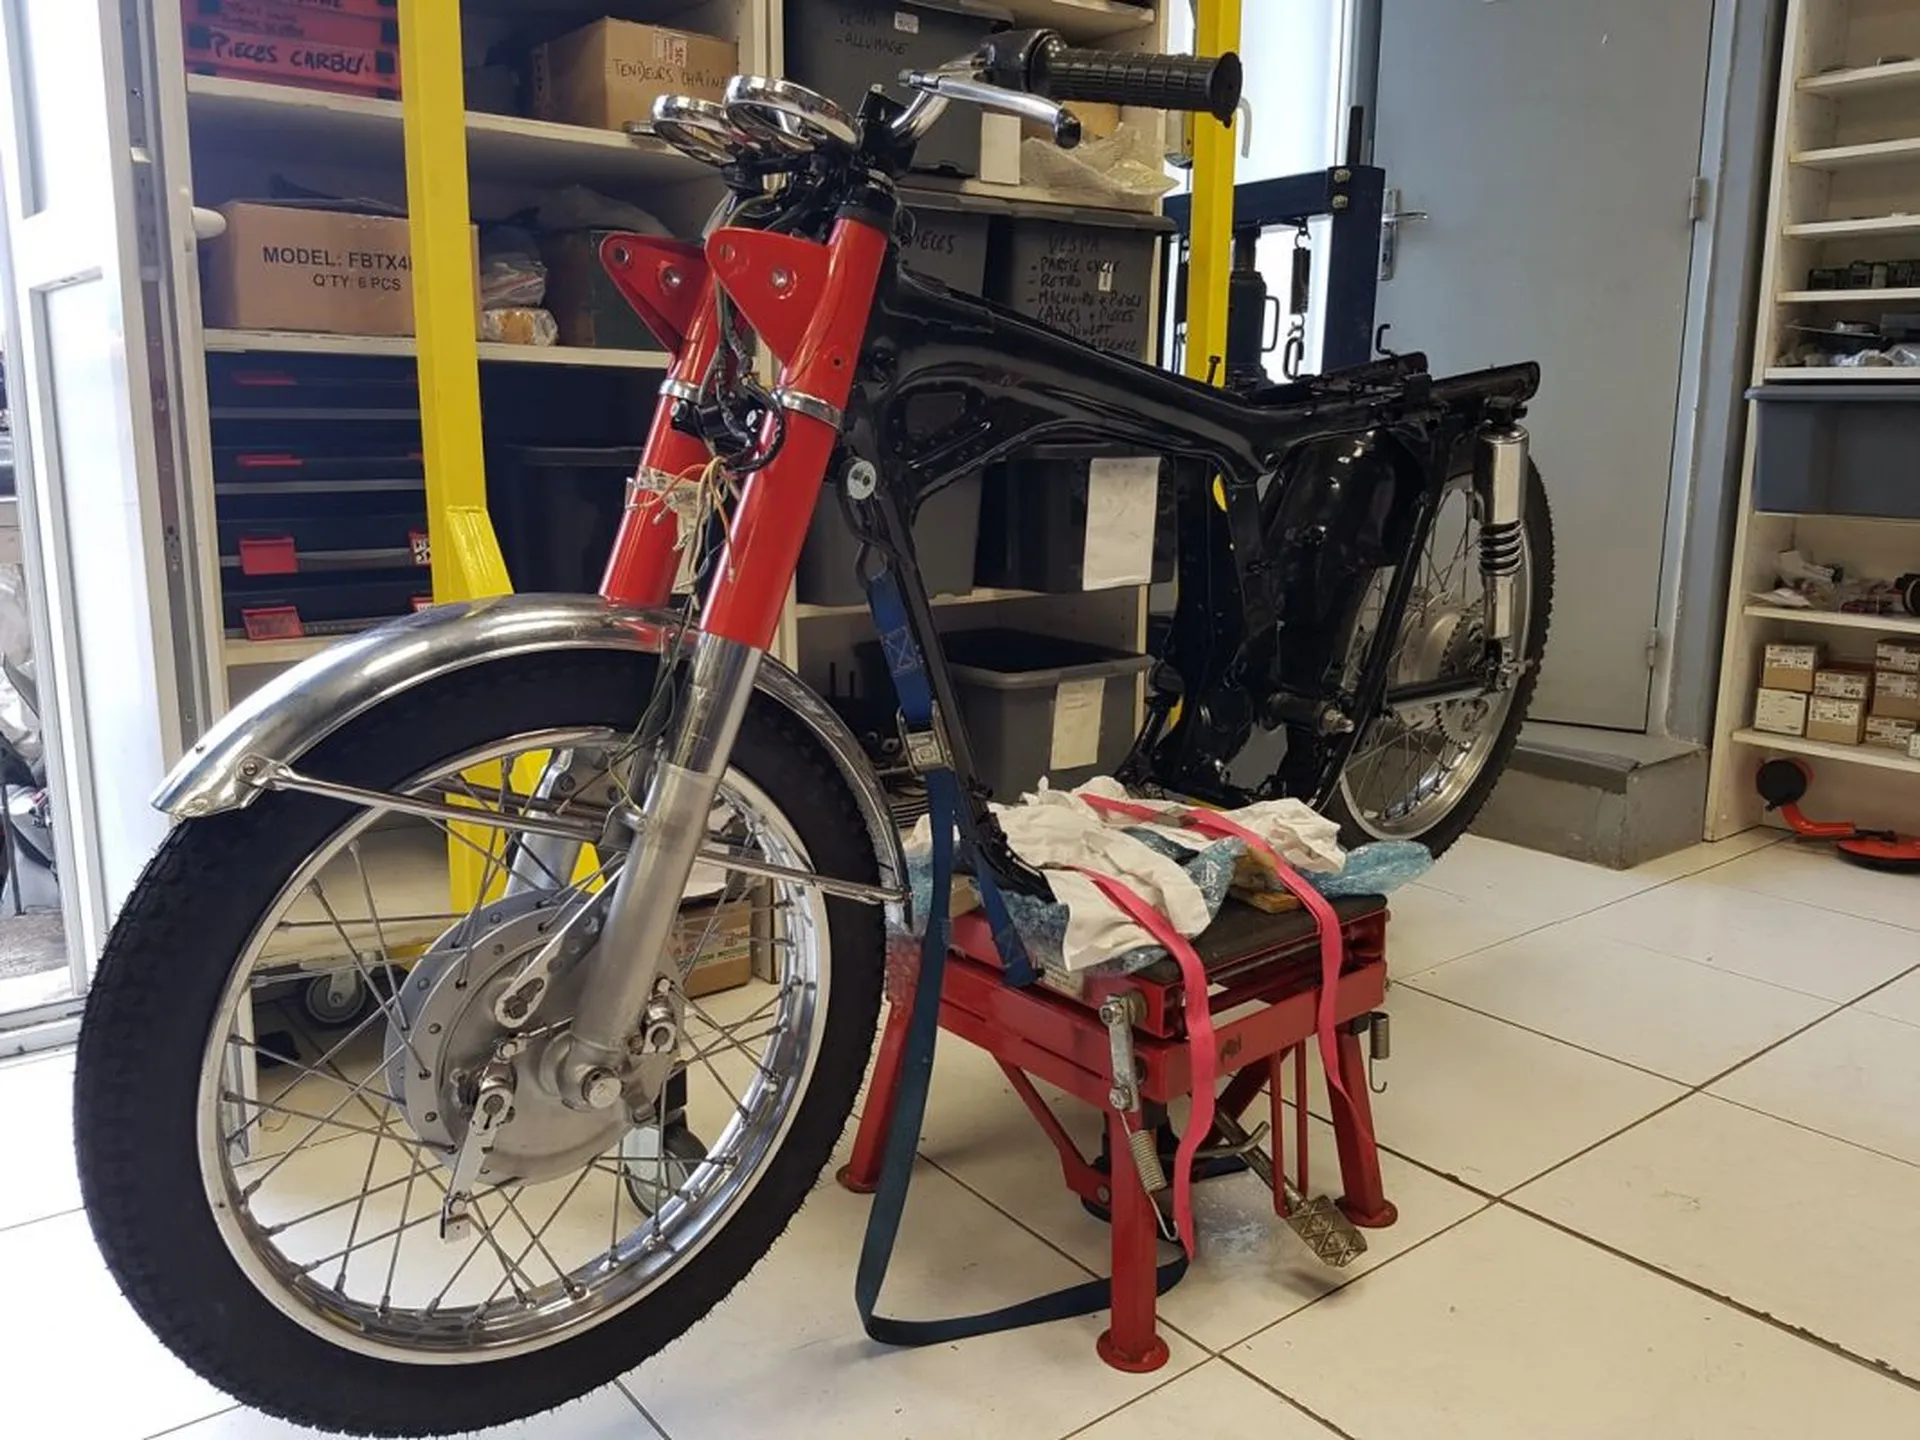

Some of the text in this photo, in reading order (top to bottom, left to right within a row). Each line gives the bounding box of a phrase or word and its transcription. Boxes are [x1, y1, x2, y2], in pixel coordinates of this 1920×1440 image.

[613, 58, 674, 83] TENDEURS
[262, 246, 412, 271] MODEL: FBTX4
[371, 277, 402, 291] PCS
